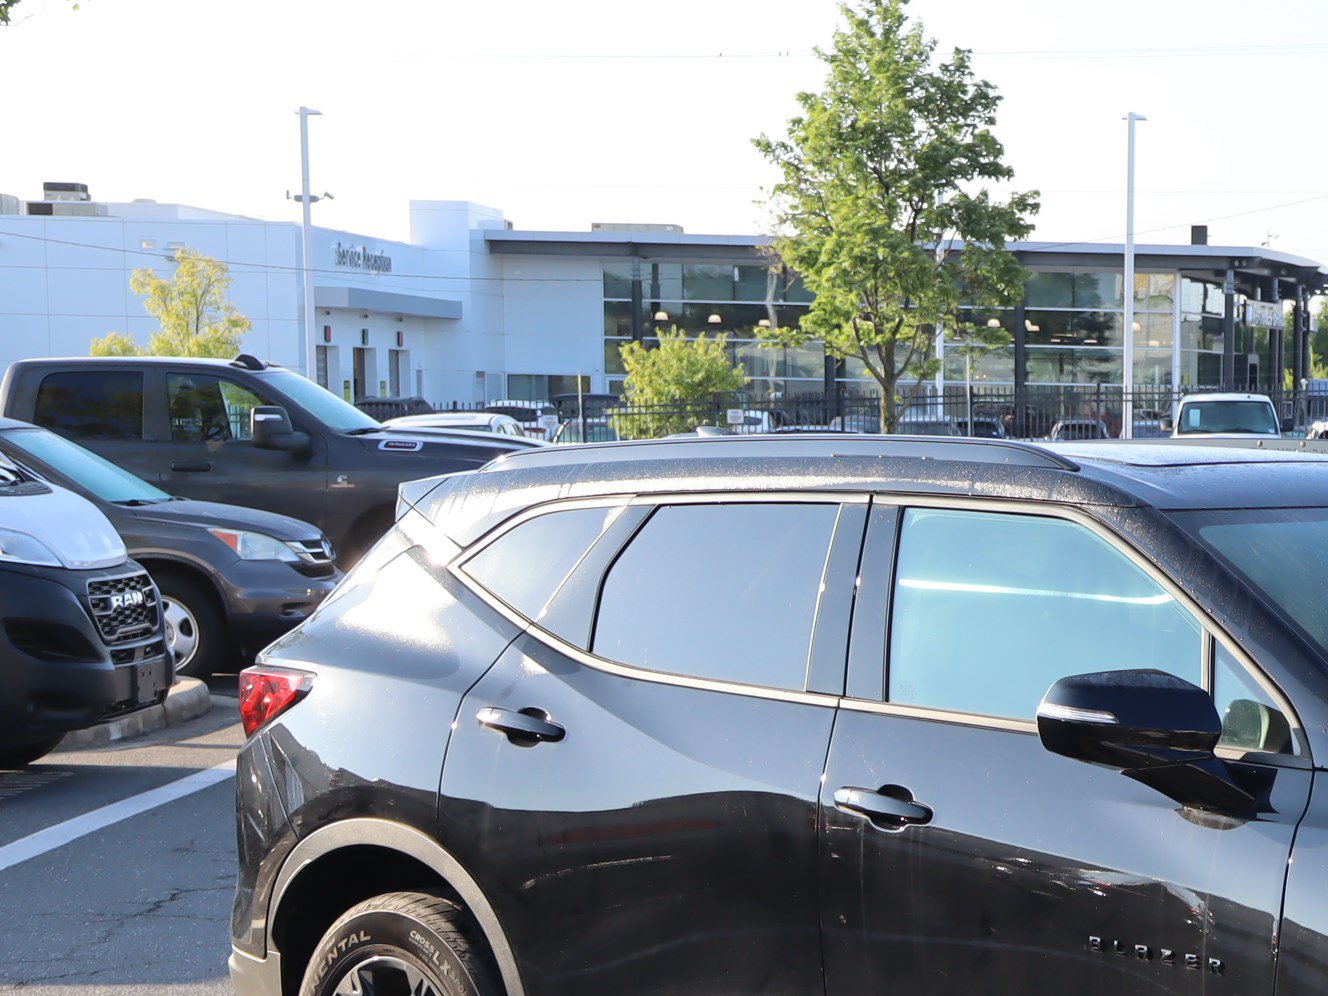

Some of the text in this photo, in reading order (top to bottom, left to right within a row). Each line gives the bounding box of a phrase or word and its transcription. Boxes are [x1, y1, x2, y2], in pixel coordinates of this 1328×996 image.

[335, 242, 392, 277] Service Reception
[111, 591, 143, 608] RAM
[1089, 935, 1226, 976] BLAZER
